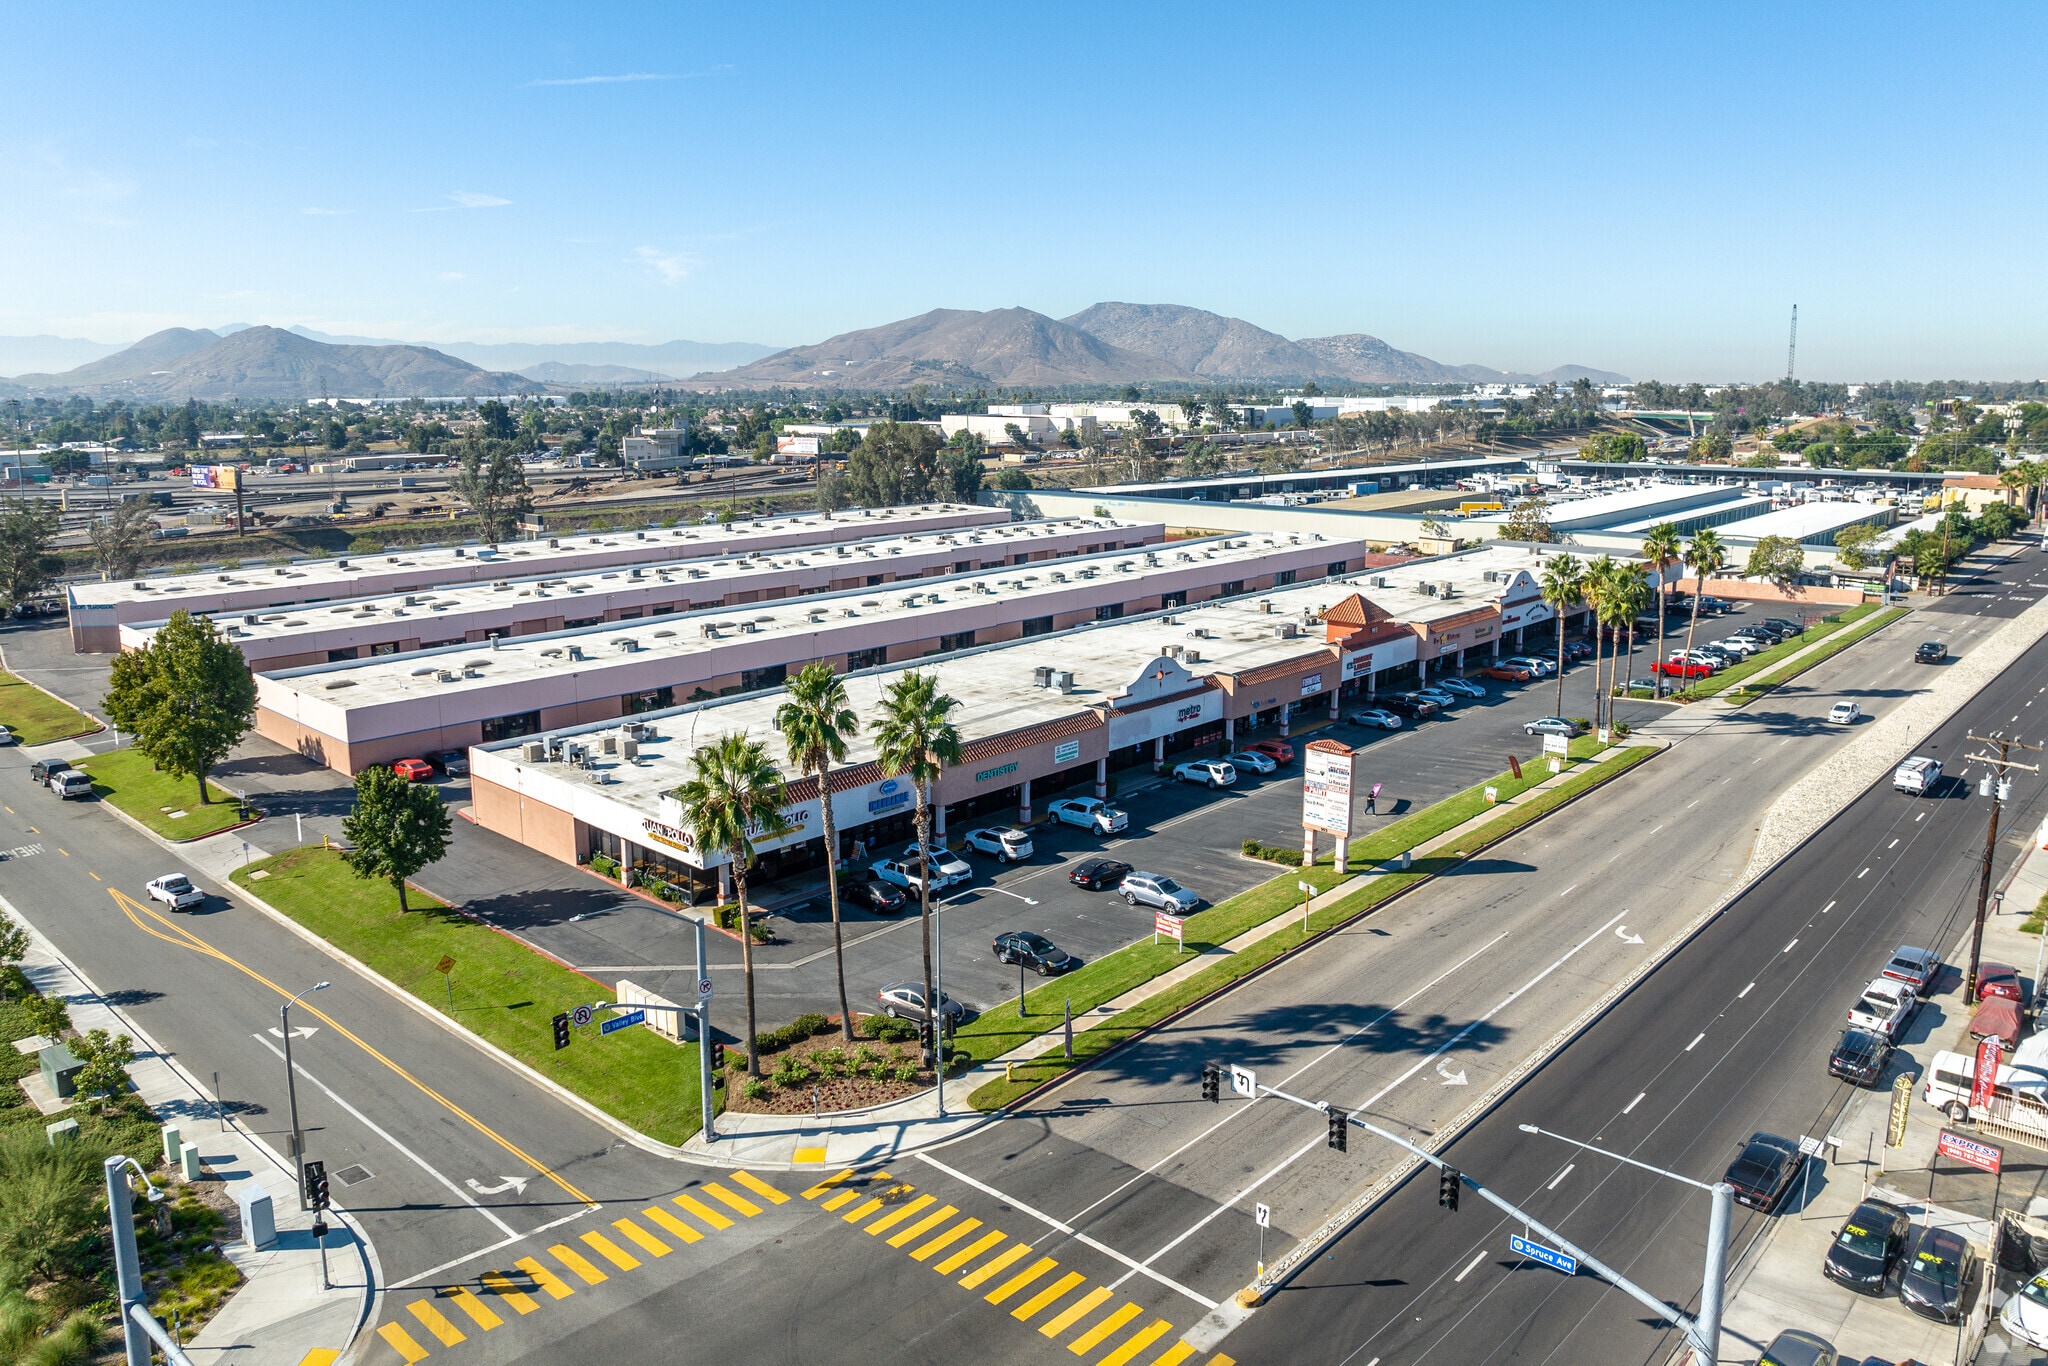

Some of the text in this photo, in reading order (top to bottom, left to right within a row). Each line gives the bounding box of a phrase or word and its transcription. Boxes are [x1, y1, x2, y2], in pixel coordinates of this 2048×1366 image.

[1178, 703, 1201, 717] metro
[976, 761, 1019, 782] DENTISTRY
[785, 809, 809, 826] OLLO
[612, 1013, 643, 1029] Valley Blvd
[1942, 1133, 1999, 1158] EXPRESS
[1525, 1244, 1572, 1269] Spruce Ave
